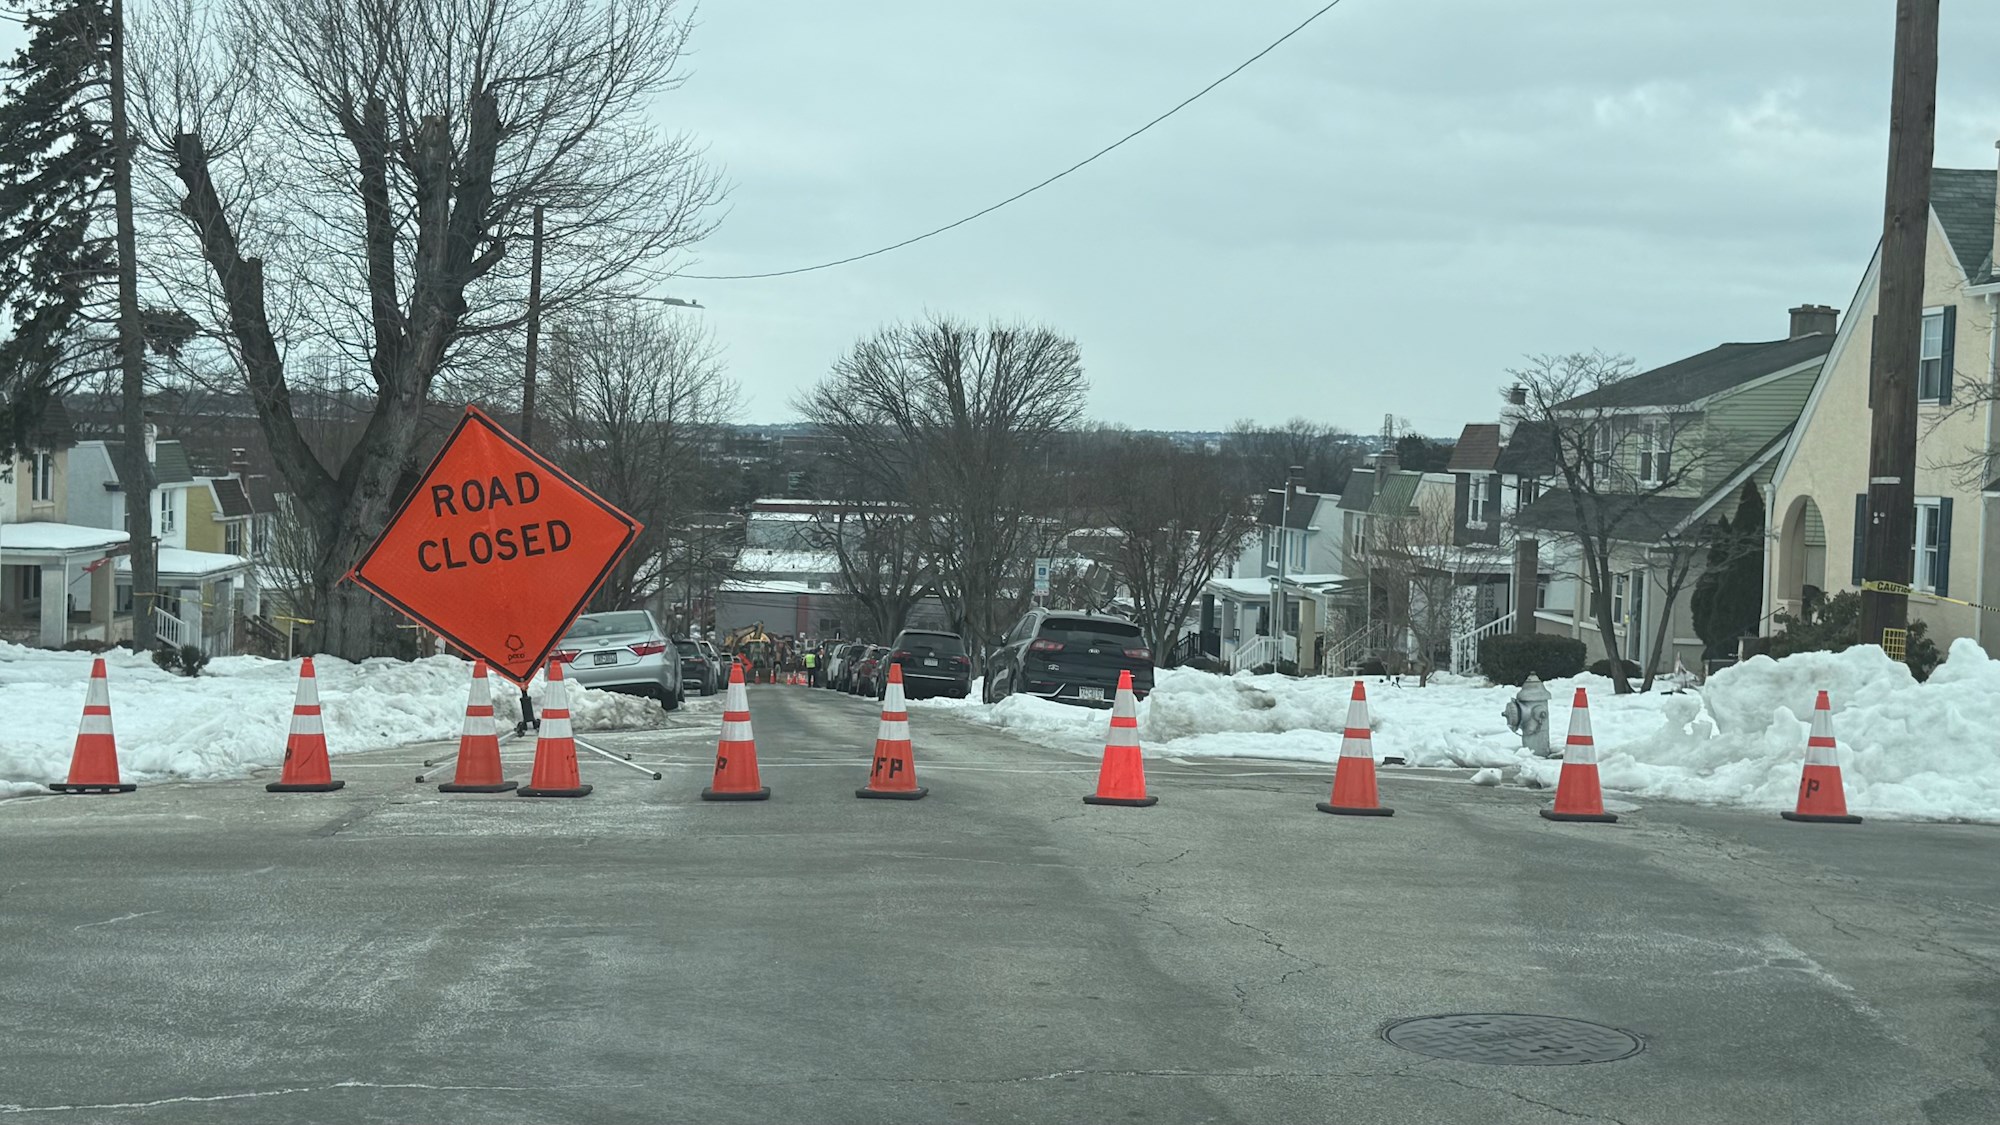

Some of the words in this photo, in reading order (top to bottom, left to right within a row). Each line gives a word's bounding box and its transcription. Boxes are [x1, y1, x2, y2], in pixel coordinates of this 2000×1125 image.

[431, 471, 540, 518] ROAD
[418, 520, 572, 572] CLOSED
[1877, 582, 1912, 594] CAUTION
[870, 757, 903, 779] FP
